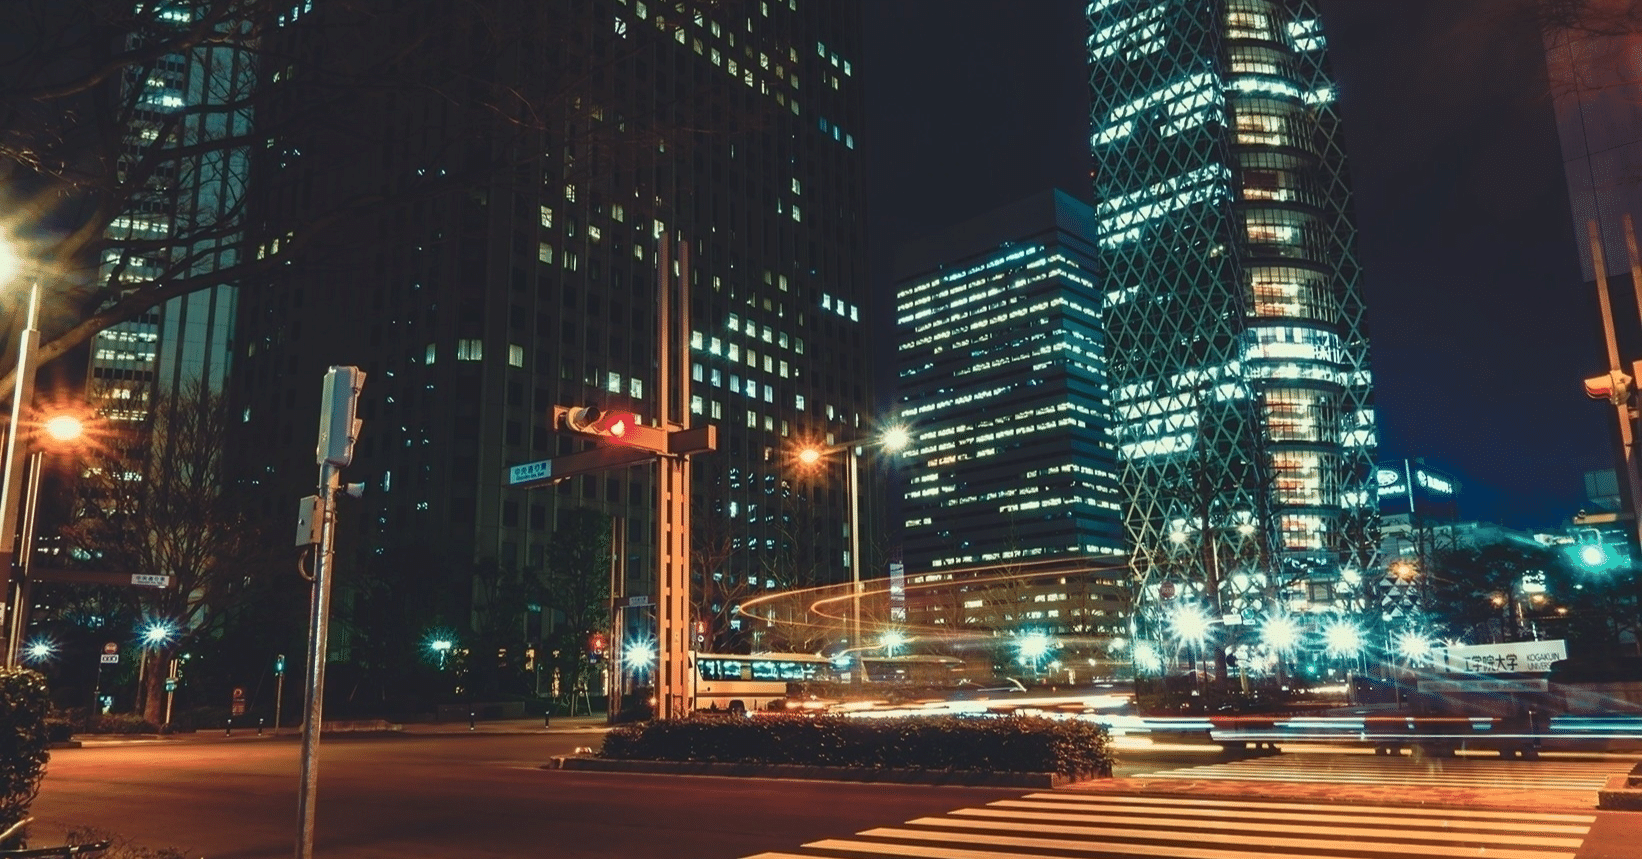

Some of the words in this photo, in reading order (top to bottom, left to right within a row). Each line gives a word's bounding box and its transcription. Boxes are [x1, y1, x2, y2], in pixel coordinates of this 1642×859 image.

[1526, 652, 1560, 662] KOGAKUIN
[1464, 654, 1518, 672] 工学院大学
[1527, 661, 1552, 671] UNIVERS
